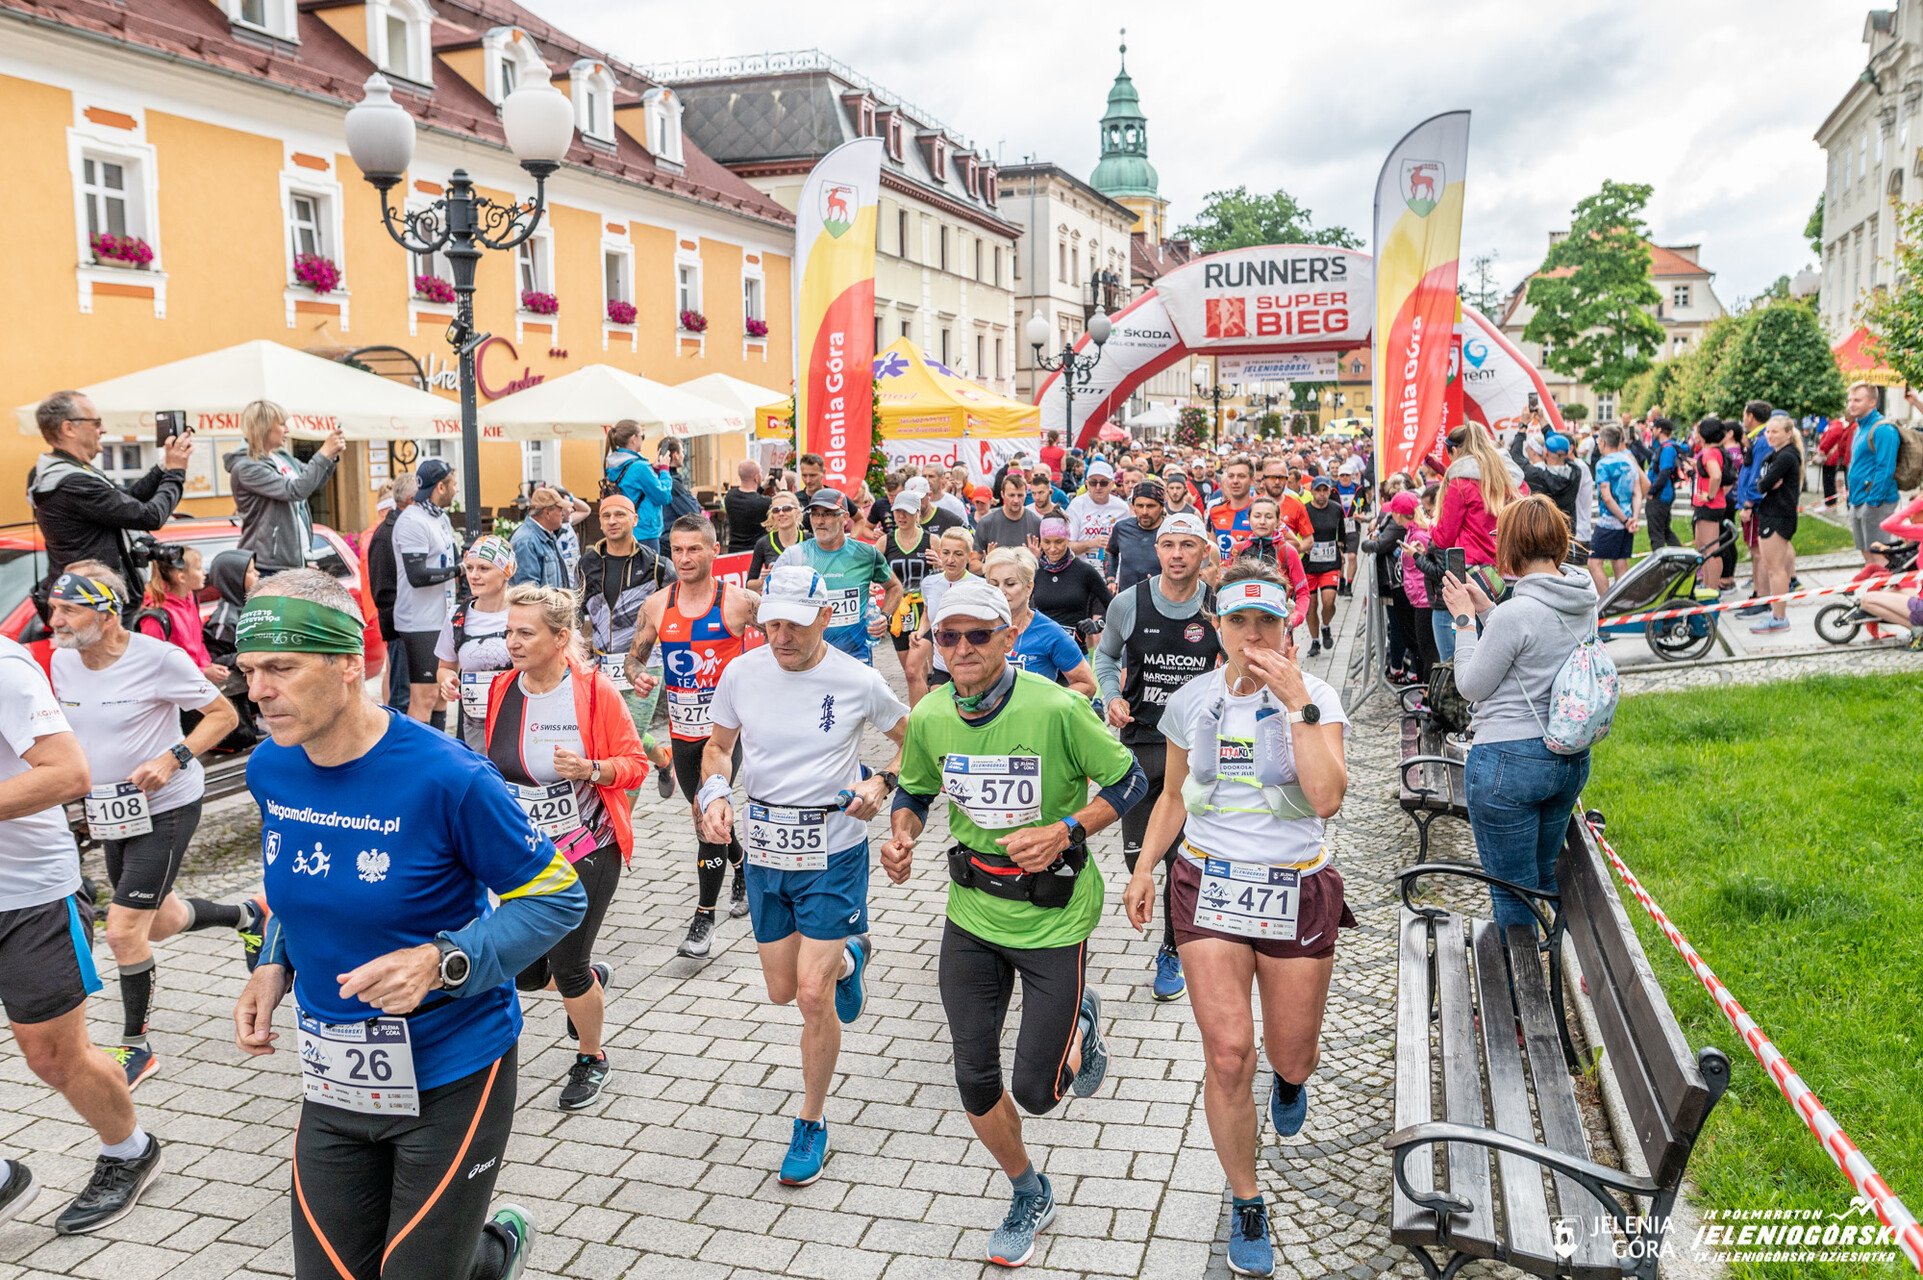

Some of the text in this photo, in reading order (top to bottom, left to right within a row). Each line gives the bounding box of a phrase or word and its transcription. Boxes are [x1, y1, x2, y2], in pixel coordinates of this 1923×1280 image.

[1205, 256, 1347, 288] RUNNER'S
[1257, 292, 1348, 309] SUPER
[1124, 328, 1172, 339] ŠKODA
[1256, 309, 1349, 336] BIEG
[411, 351, 461, 392] Hotel
[825, 331, 845, 393] Góra
[198, 413, 240, 429] TYSKI
[432, 419, 462, 433] TYSK
[824, 397, 847, 484] Jelenia
[831, 600, 857, 614] 210
[1143, 653, 1207, 668] MARCONI
[677, 677, 714, 689] TEAM
[562, 724, 580, 732] KRO
[981, 779, 1034, 805] 570
[100, 798, 142, 821] 108
[266, 799, 401, 836] biegamdlazdrowia.pl
[529, 798, 572, 821] 420
[776, 828, 821, 849] 355
[1238, 886, 1289, 915] 471
[346, 1048, 393, 1081] 26
